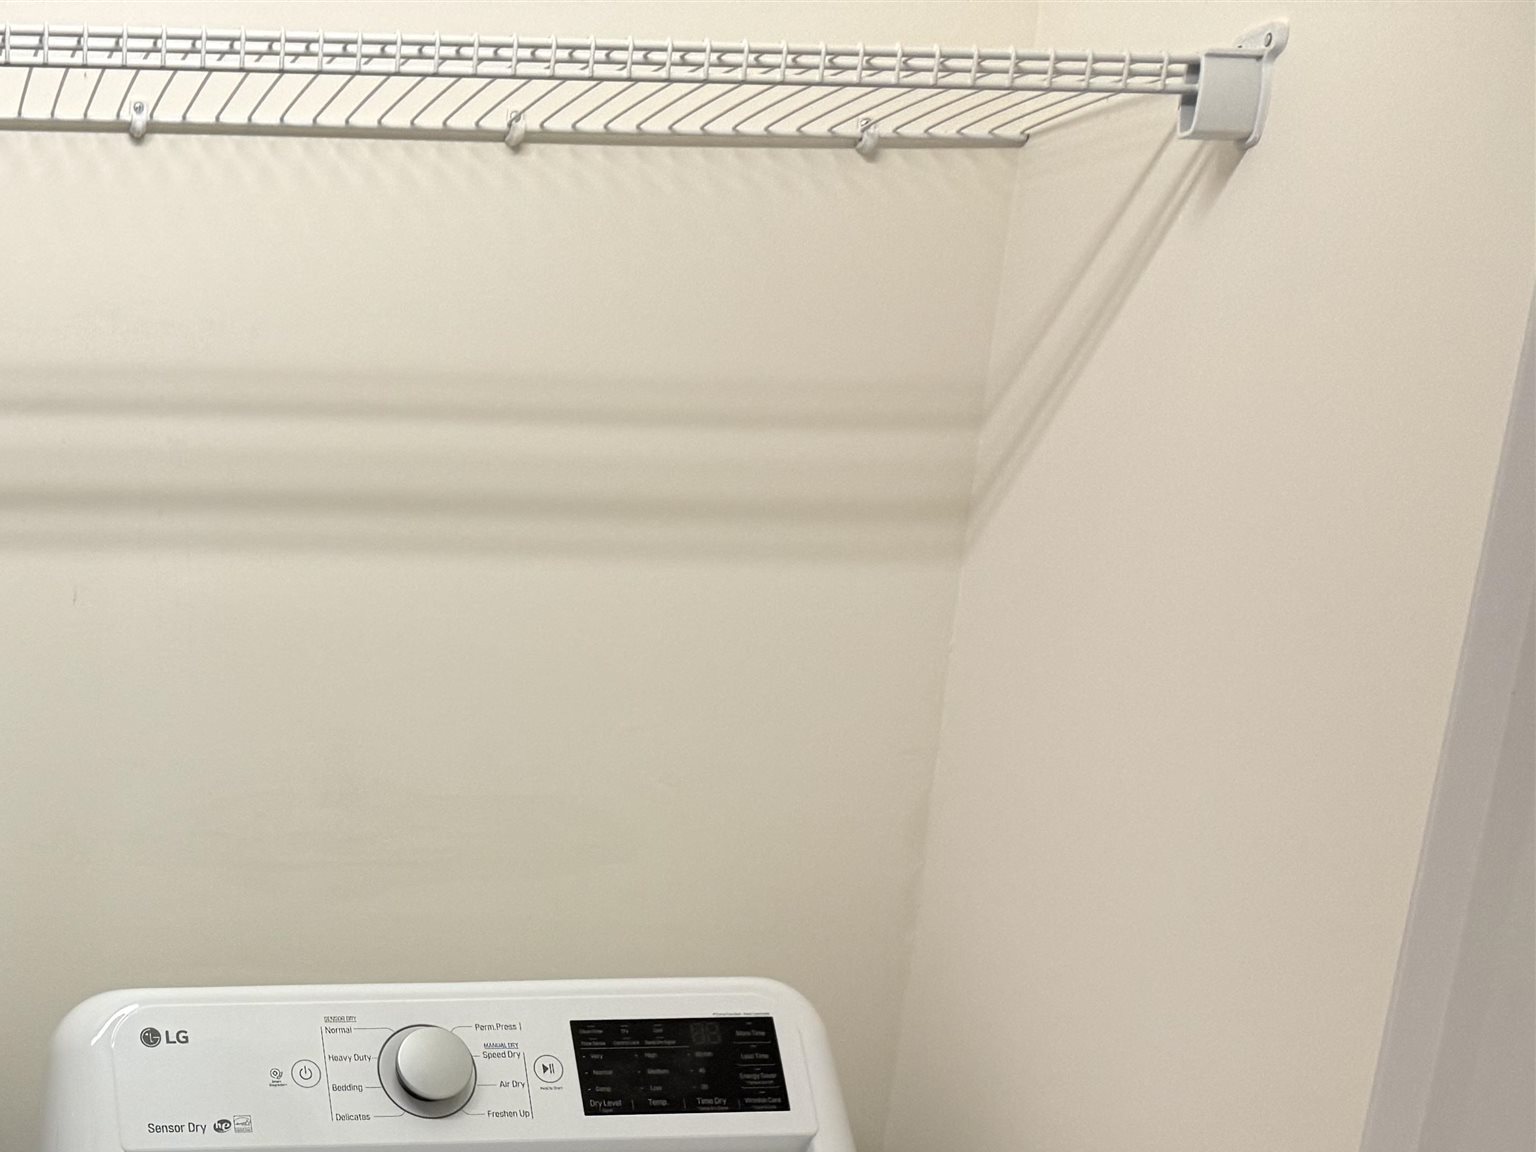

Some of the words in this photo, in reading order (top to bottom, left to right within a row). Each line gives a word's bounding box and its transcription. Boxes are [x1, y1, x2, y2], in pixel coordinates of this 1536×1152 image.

[324, 1026, 352, 1034] Normal
[165, 1030, 189, 1044] LG
[328, 1054, 352, 1063] Heavy
[353, 1053, 371, 1062] Duty
[482, 1051, 506, 1060] Speed
[507, 1050, 521, 1060] Dry
[332, 1083, 363, 1093] Bedding
[499, 1080, 510, 1088] Air
[512, 1080, 526, 1089] Dry
[589, 1099, 602, 1108] Dry
[603, 1099, 622, 1107] Level
[714, 1097, 727, 1106] Dry
[335, 1113, 371, 1121] Delicates
[487, 1110, 518, 1118] Freshen
[519, 1110, 531, 1118] Up
[147, 1122, 185, 1133] Sensor
[188, 1122, 207, 1134] Dry
